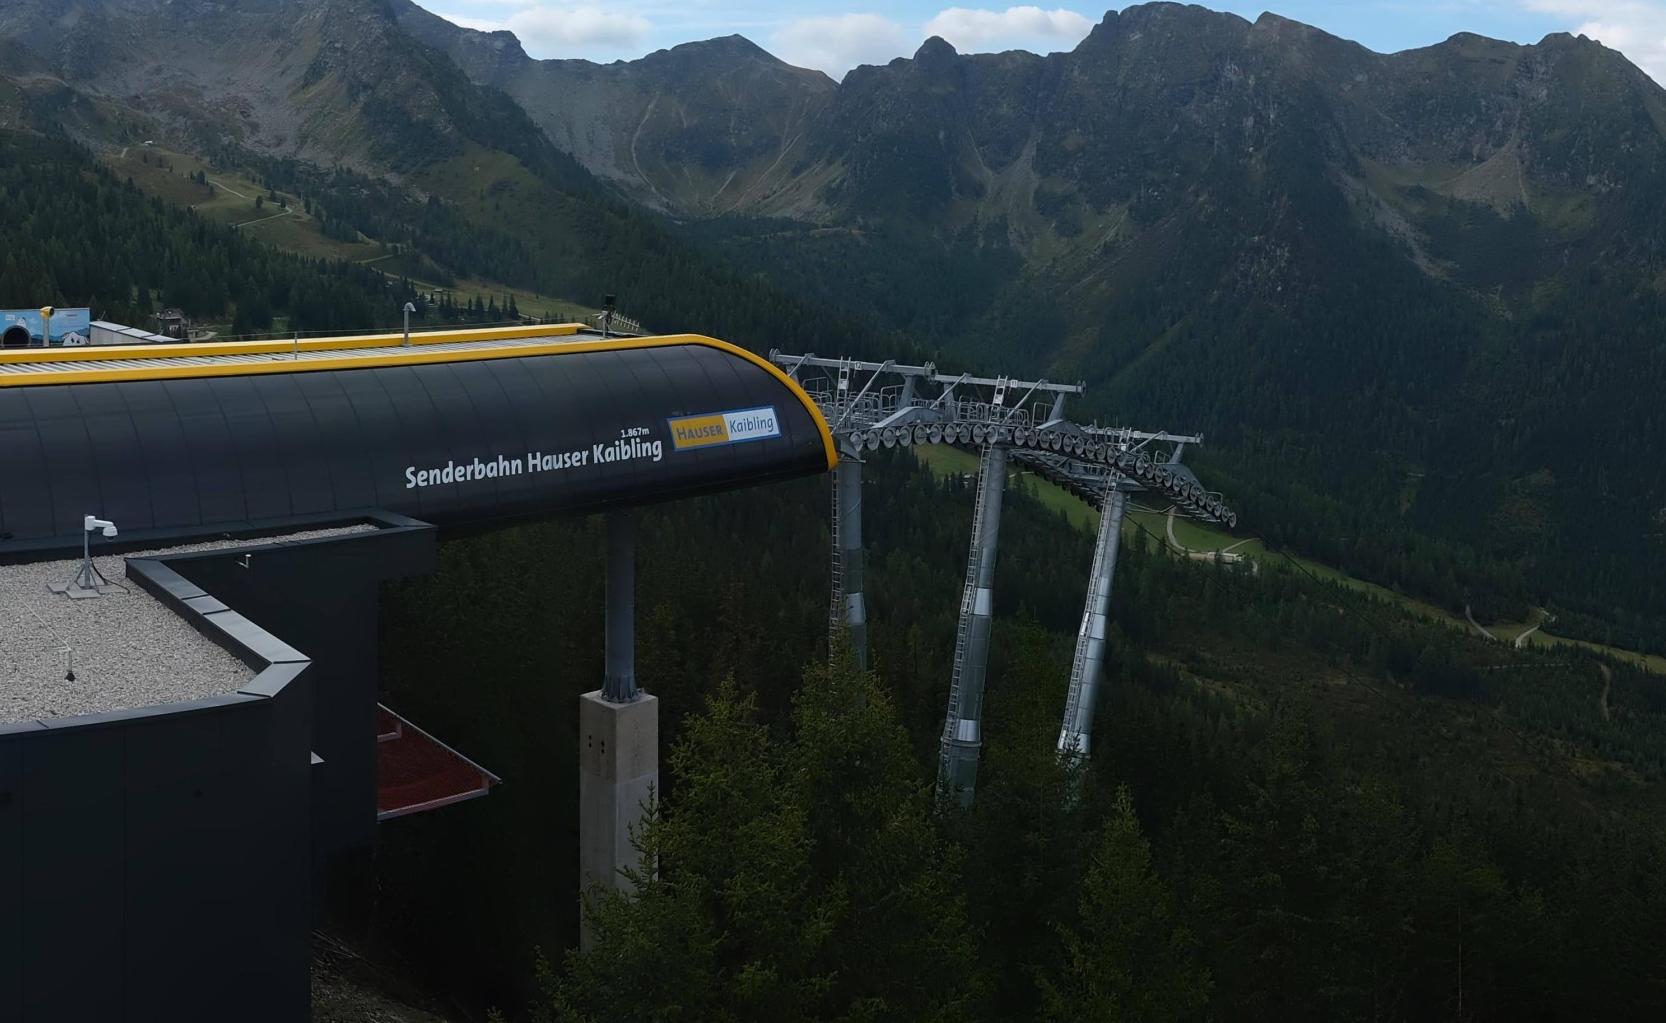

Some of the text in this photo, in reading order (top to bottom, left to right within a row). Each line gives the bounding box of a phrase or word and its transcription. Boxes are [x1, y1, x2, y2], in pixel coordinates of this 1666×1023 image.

[620, 426, 650, 439] 1.867m
[676, 414, 775, 442] HAUSER Kaibling
[405, 437, 663, 489] Senderbahn Hauser Kaibling
